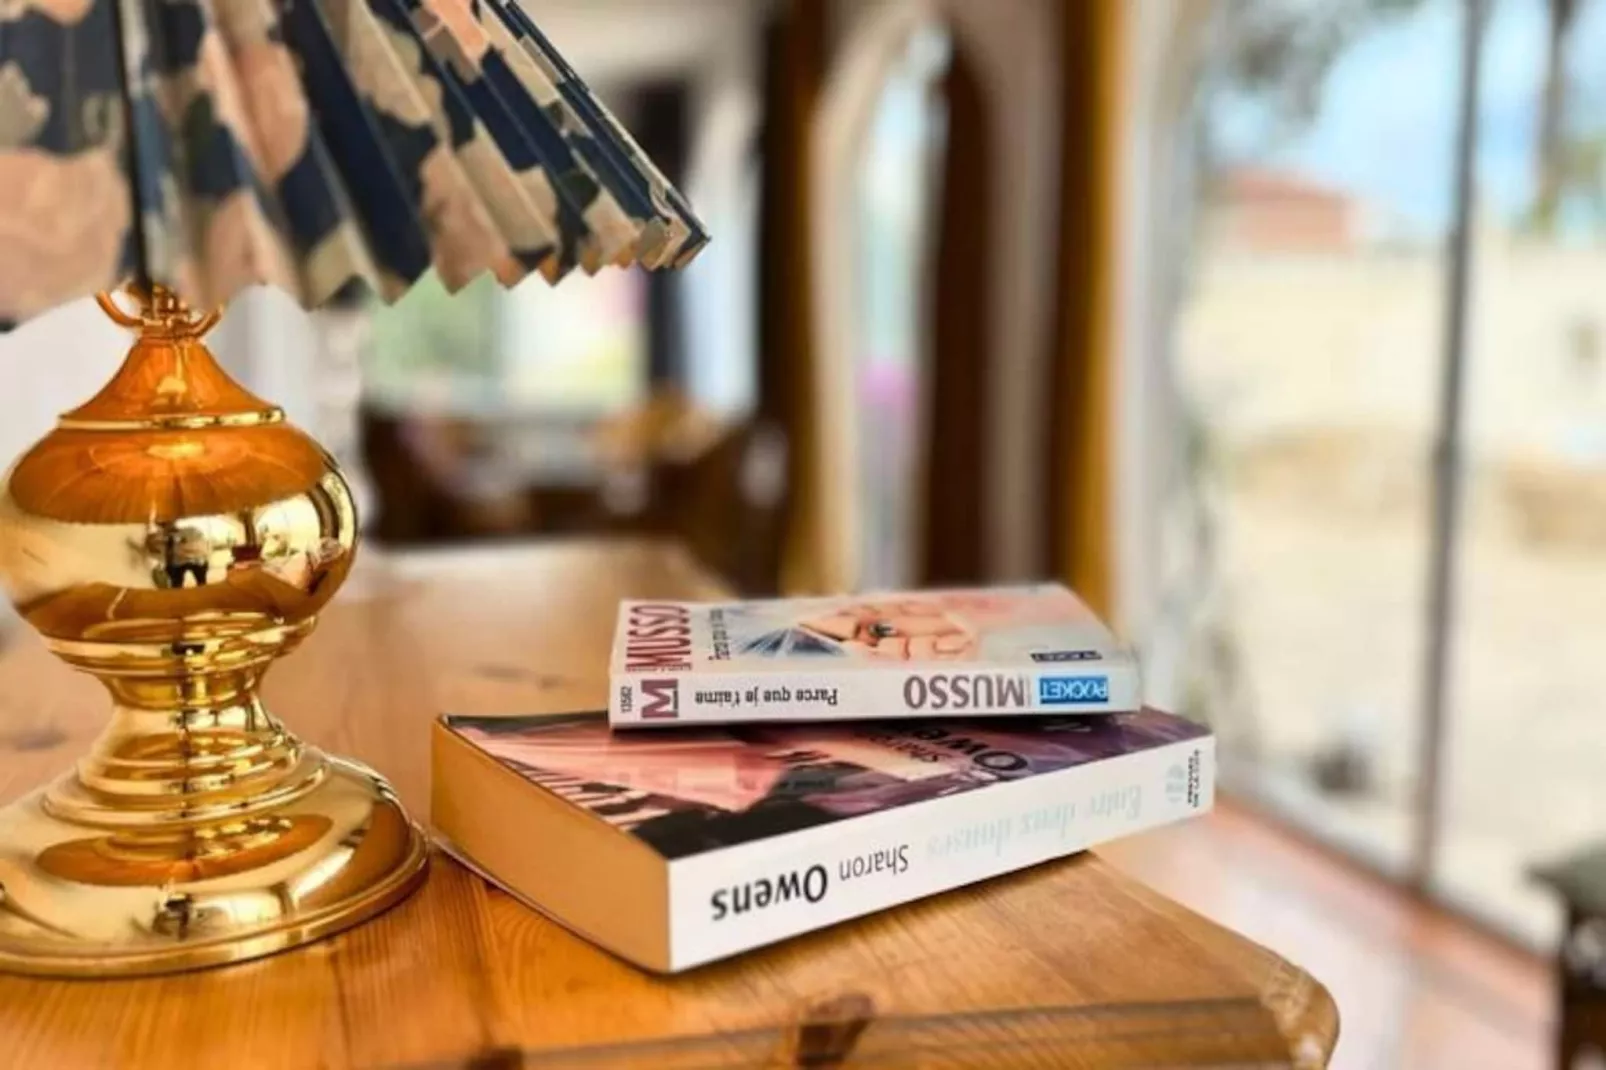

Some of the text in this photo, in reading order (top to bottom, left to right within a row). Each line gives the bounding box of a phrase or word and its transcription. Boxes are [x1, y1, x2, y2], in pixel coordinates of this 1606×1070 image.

[625, 604, 692, 668] MUSSO
[695, 687, 838, 708] Parce que je t'aime
[903, 674, 1025, 709] MUSSO
[1041, 679, 1107, 699] POCKET
[710, 844, 910, 921] Sharon Owens
